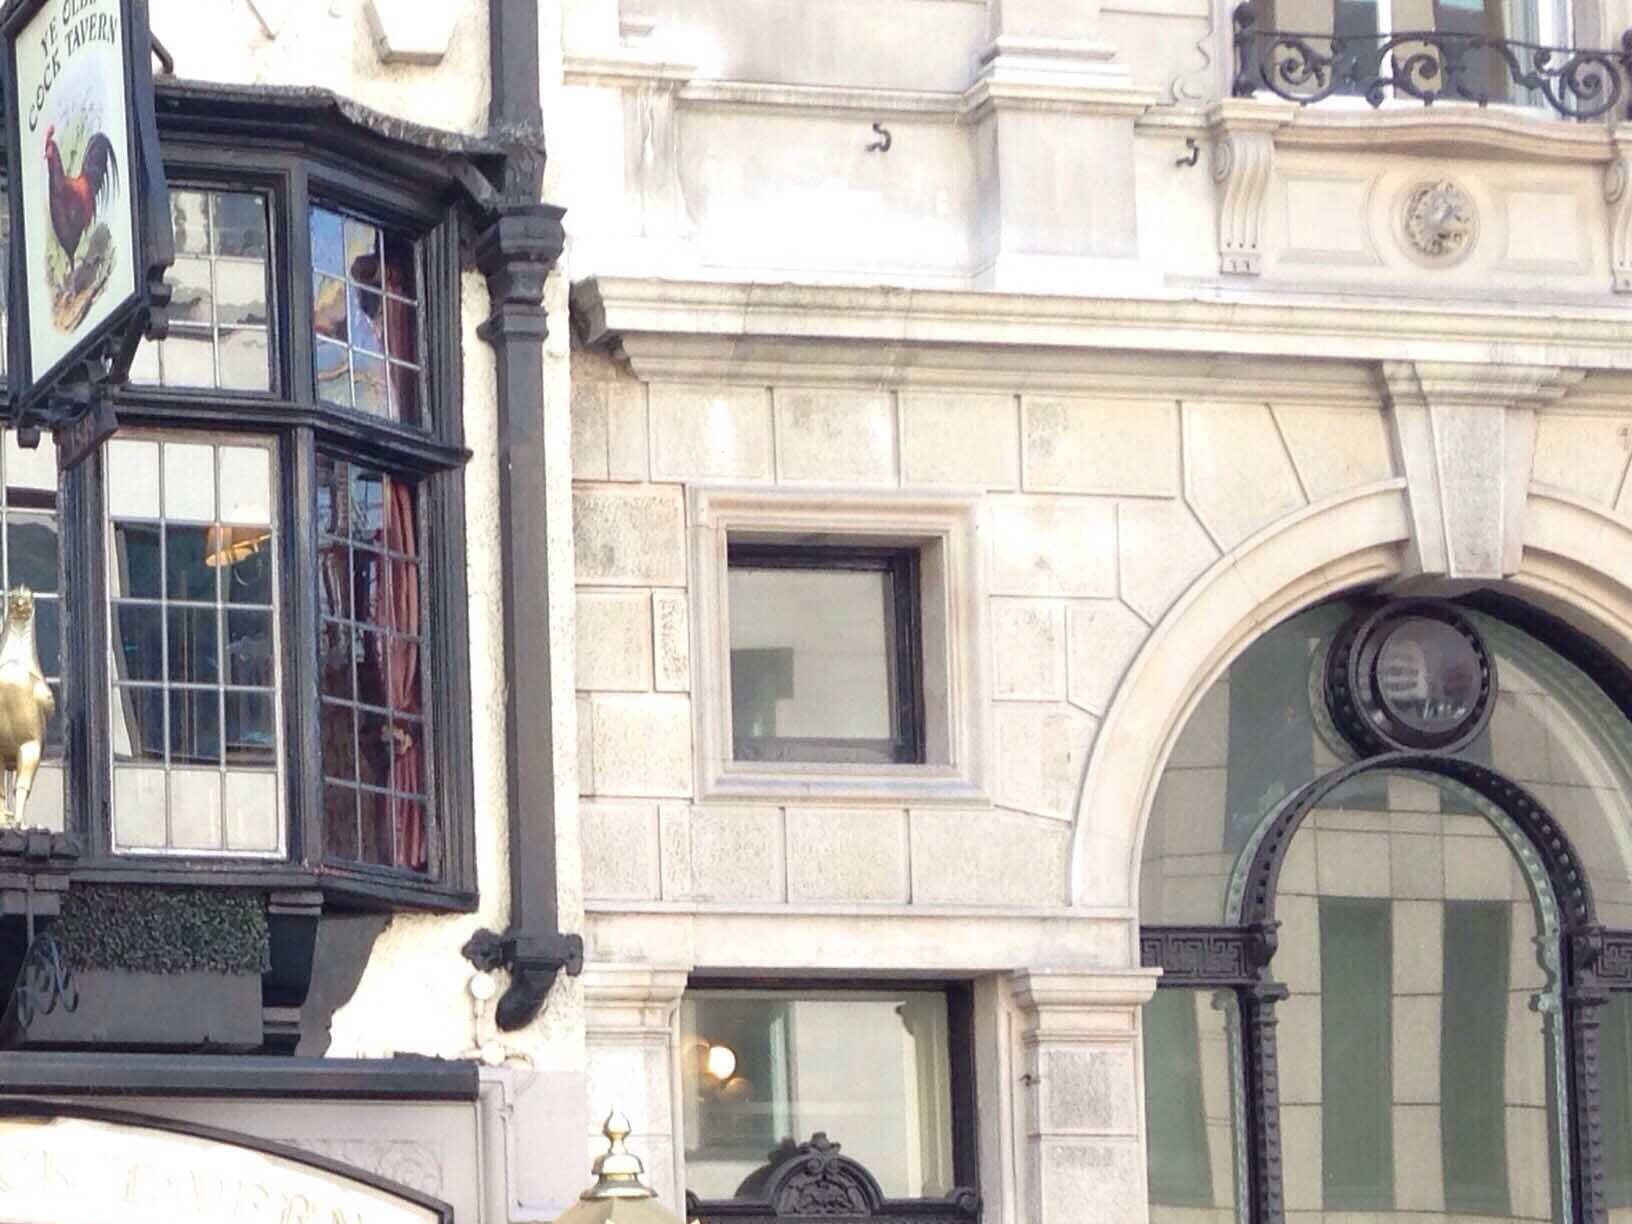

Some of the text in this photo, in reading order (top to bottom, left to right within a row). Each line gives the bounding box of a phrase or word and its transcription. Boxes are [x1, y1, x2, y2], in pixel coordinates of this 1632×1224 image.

[29, 11, 118, 132] COCK TAVERN
[41, 0, 96, 57] YE OL
